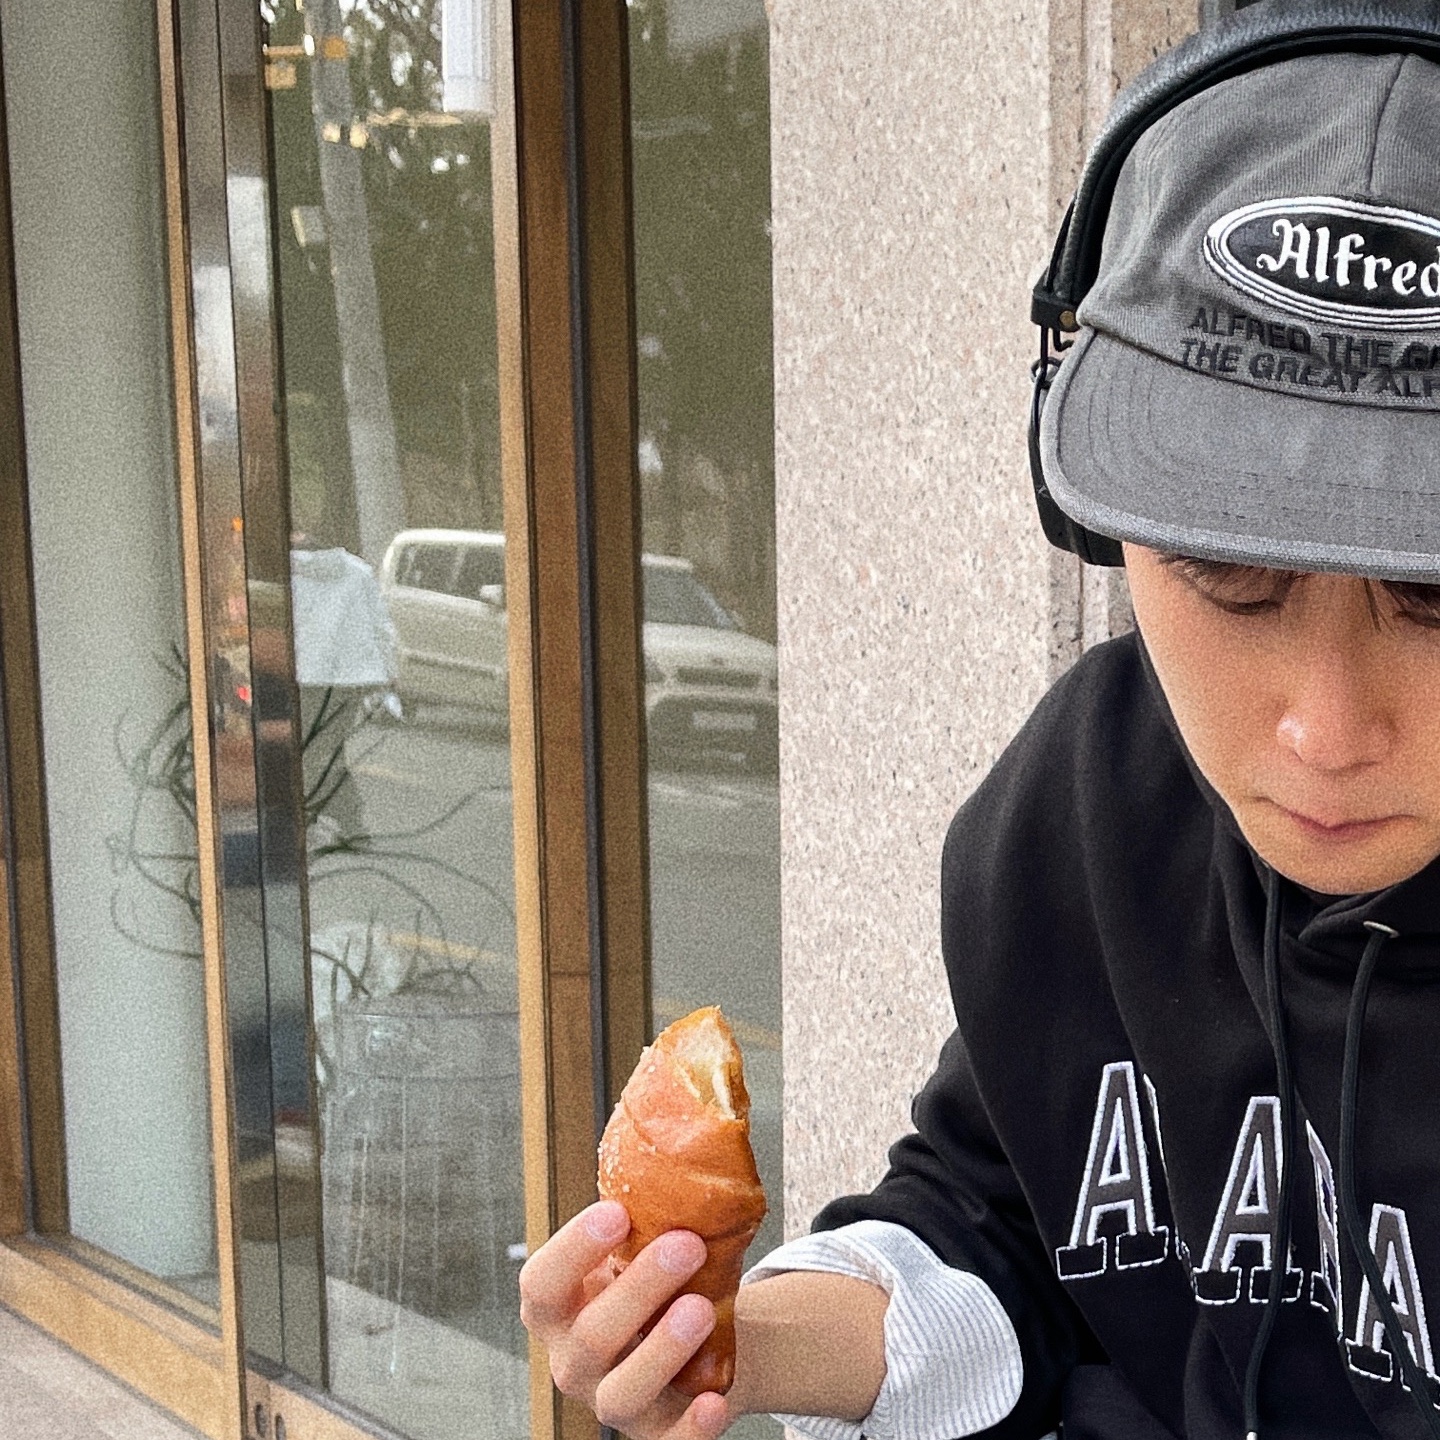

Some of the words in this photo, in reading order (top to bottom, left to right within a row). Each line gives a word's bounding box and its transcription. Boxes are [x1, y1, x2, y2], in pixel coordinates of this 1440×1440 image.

[1180, 337, 1239, 373] THE
[1248, 350, 1367, 394] GREAT
[1190, 307, 1311, 352] ALFRED
[1323, 332, 1394, 370] THE
